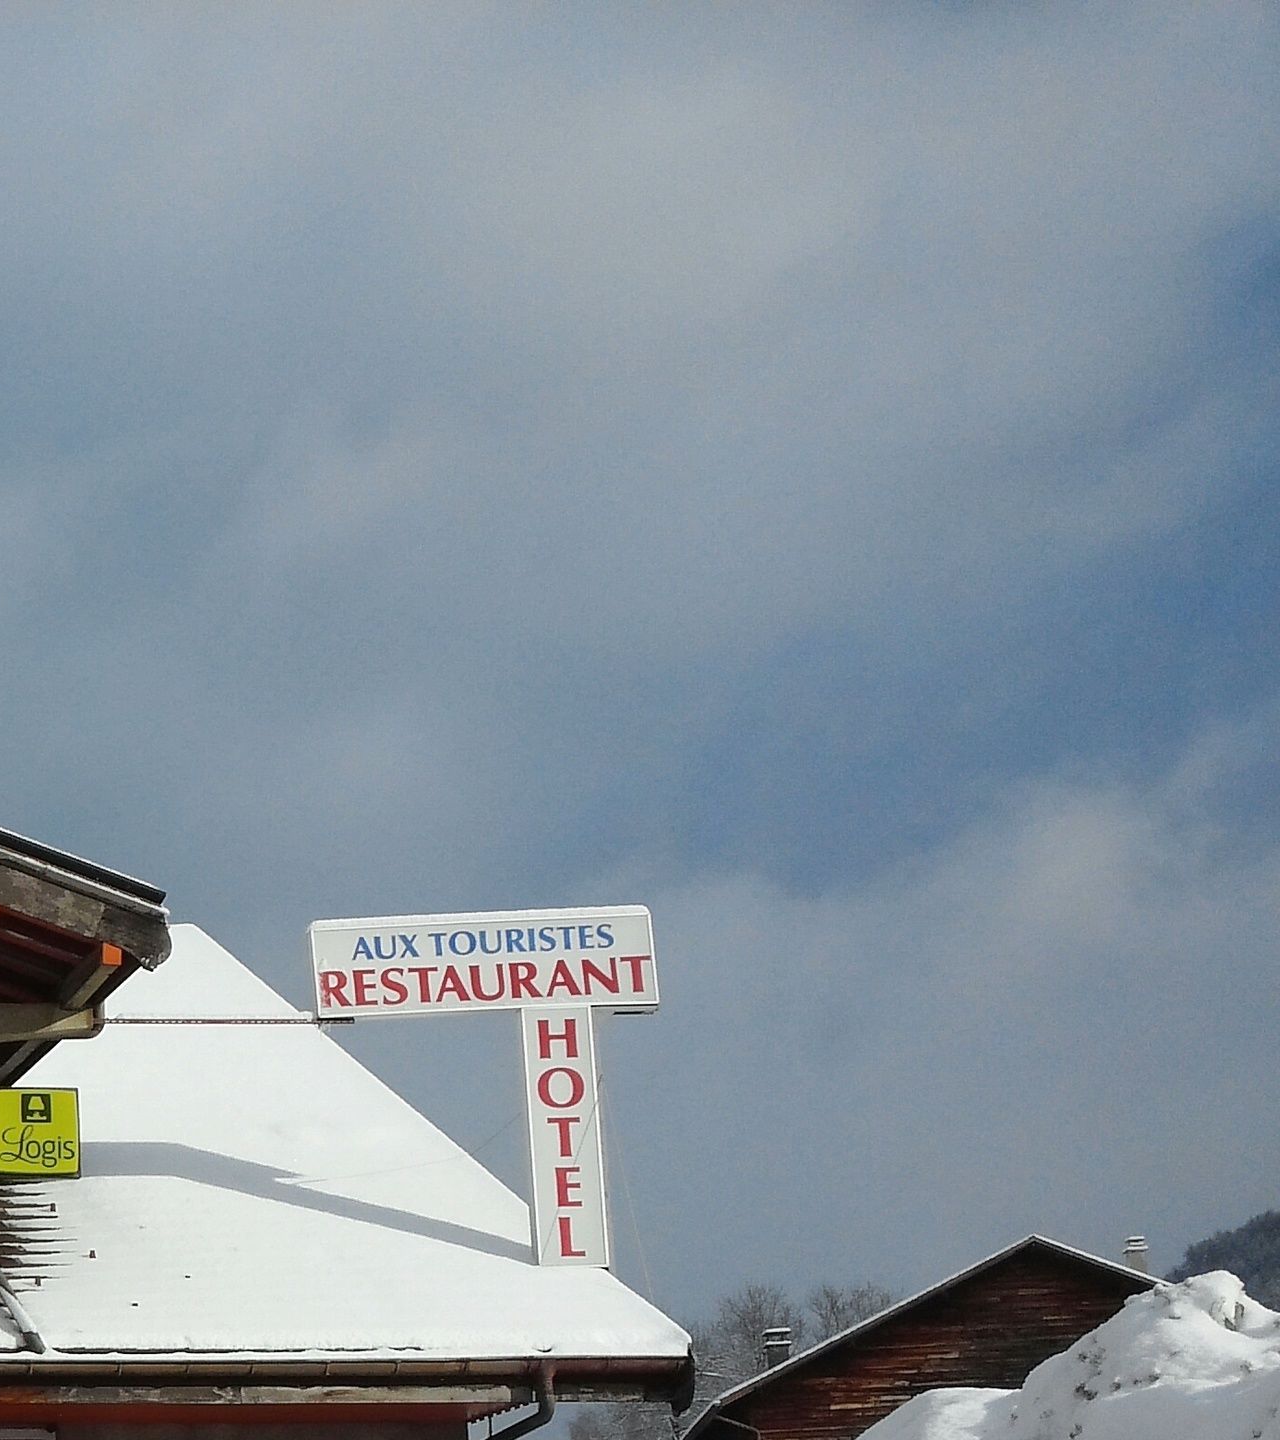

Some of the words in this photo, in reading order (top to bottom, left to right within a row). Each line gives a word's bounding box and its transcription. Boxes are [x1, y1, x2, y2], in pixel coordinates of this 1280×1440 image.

[352, 934, 419, 961] AUX
[428, 923, 615, 957] TOURISTES
[319, 955, 652, 1008] RESTAURANT
[0, 1125, 75, 1168] Logis
[537, 1018, 586, 1258] HOTEL
